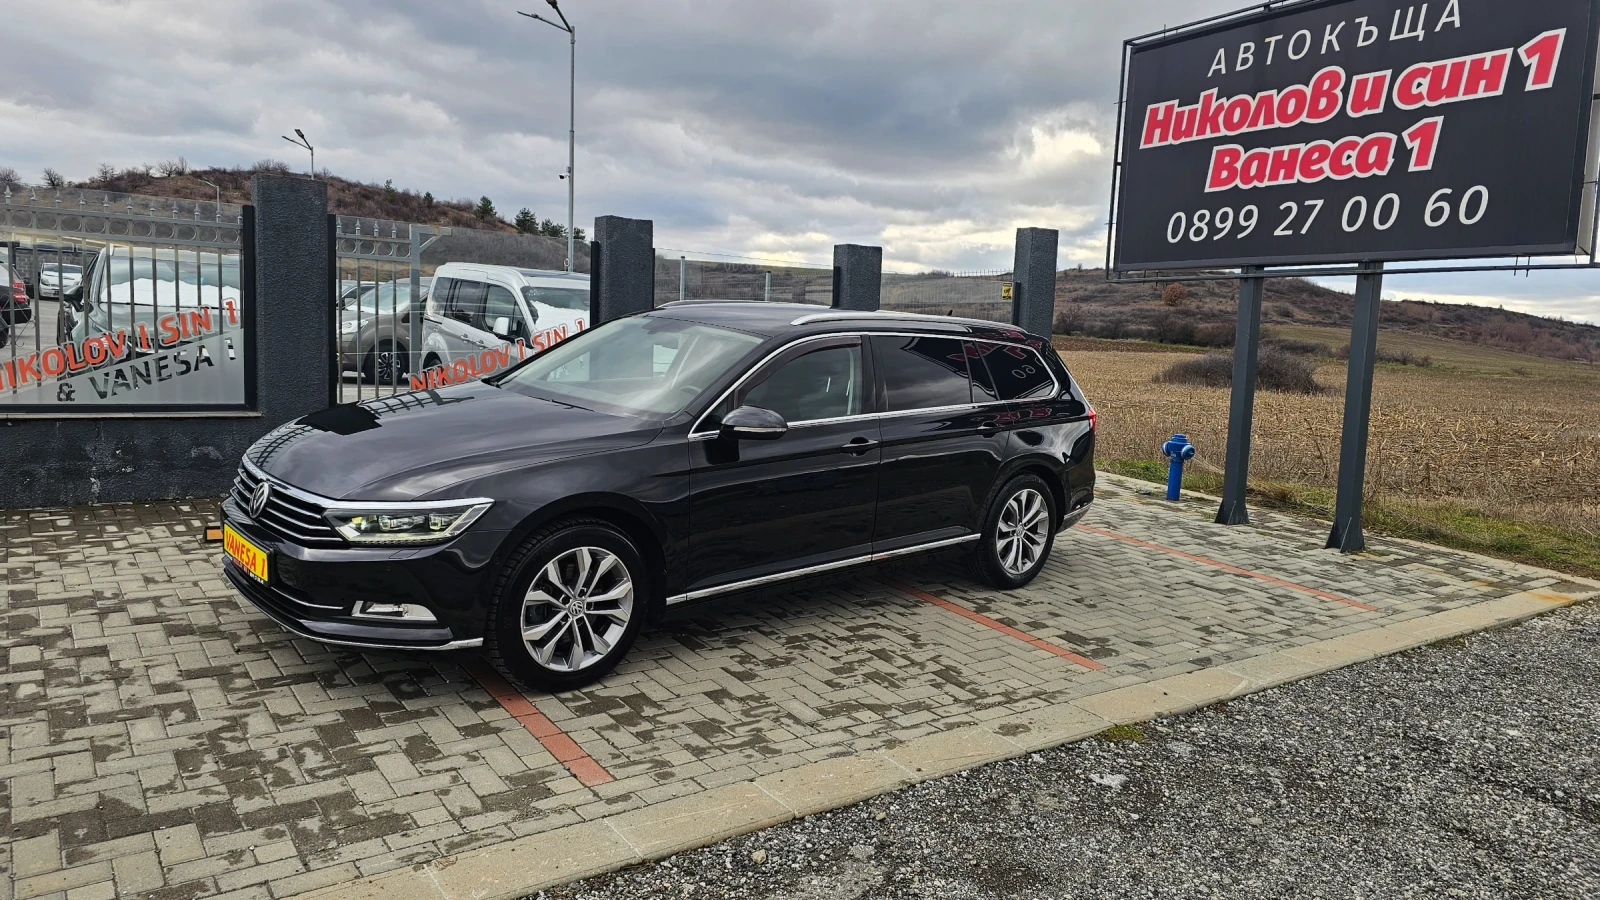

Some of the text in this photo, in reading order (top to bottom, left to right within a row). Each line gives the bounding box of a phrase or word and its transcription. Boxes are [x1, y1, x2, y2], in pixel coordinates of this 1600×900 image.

[1207, 0, 1461, 77] АВТОКЪЩА
[1140, 27, 1567, 149] Николов и син 1
[1204, 116, 1444, 193] Ванеса 1
[1166, 185, 1489, 243] 0899 27 00 60
[137, 324, 151, 350] I
[160, 305, 212, 345] SIN
[225, 300, 238, 325] 1
[57, 337, 237, 402] & VANESA 1
[410, 344, 510, 391] NIKOLOV
[532, 326, 567, 354] SIN
[225, 530, 257, 573] VANESA
